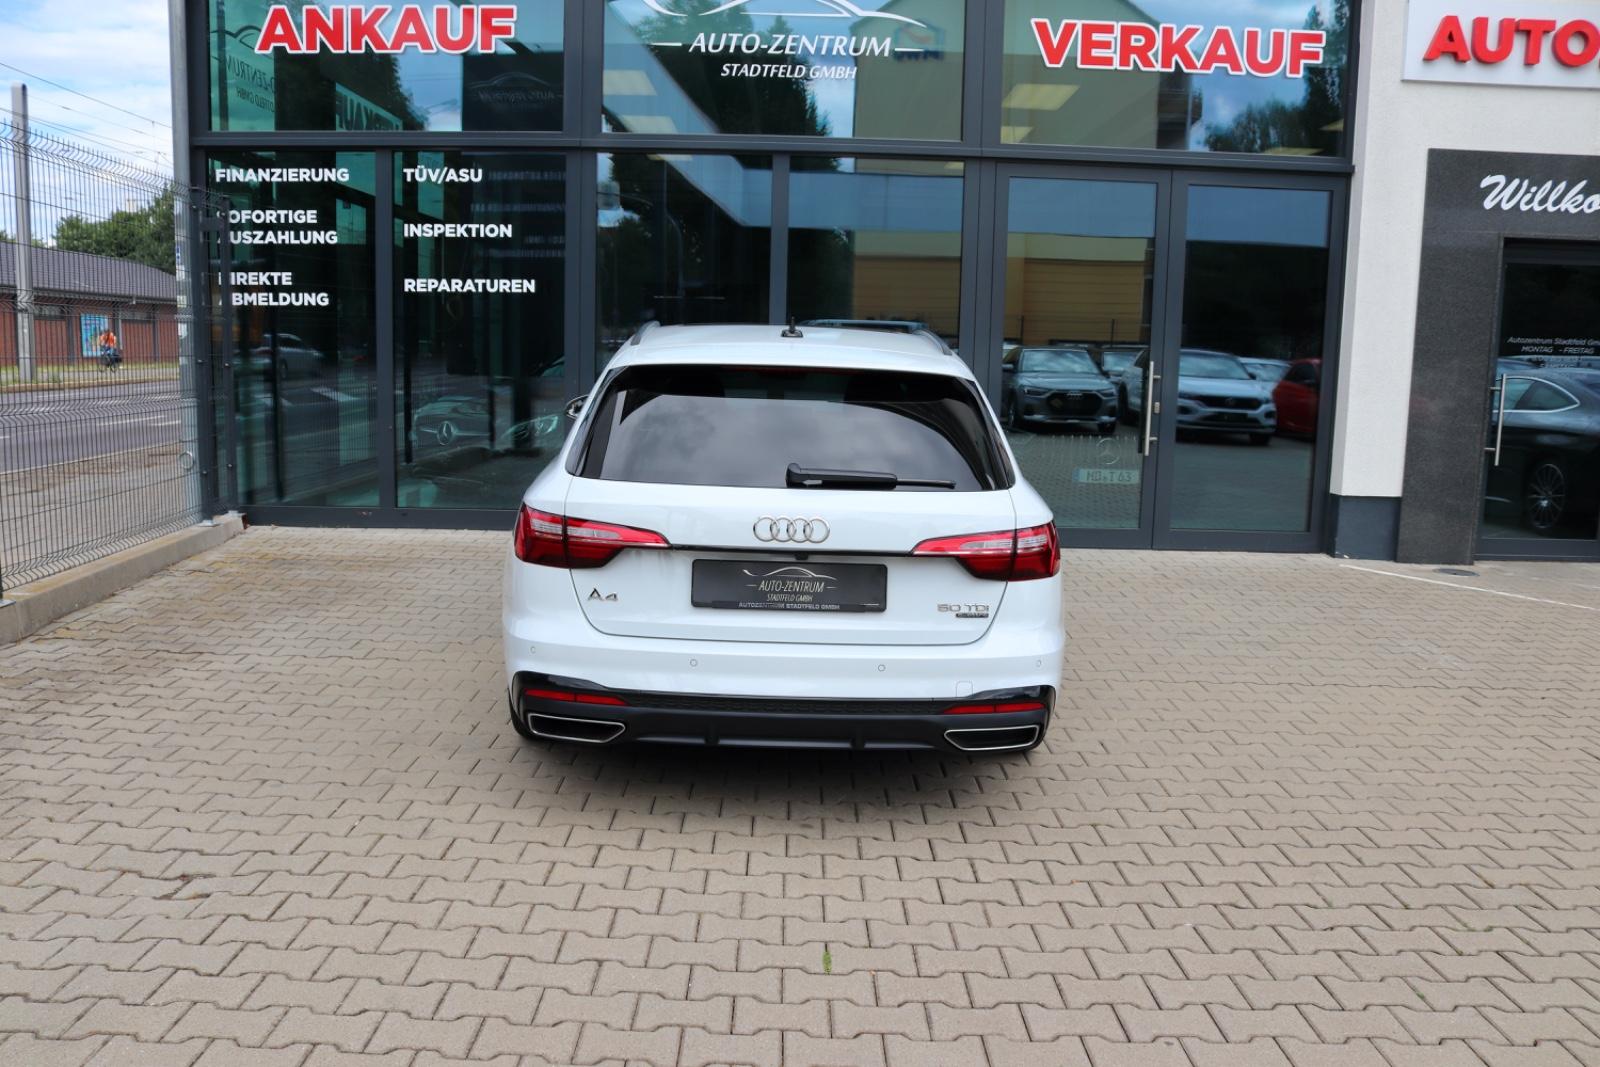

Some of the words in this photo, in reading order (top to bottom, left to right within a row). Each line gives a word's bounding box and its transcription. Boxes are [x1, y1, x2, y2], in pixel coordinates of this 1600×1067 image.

[254, 5, 517, 54] ANKAUF
[689, 33, 891, 57] AUTO-ZENTRUM
[1031, 17, 1326, 77] VERKAUF
[1423, 15, 1600, 68] AUTO
[721, 63, 806, 79] STADTFELD
[810, 65, 858, 80] GMBH
[215, 168, 350, 182] FINANZIERUNG
[403, 165, 483, 184] TÜV/ASU
[217, 230, 338, 245] USZAHLUNG
[404, 224, 513, 238] INSPEKTION
[219, 271, 293, 286] IREKTE
[404, 278, 536, 293] REPARATUREN
[219, 292, 330, 306] BMELDUNG
[1521, 345, 1553, 353] MONTAG
[1563, 346, 1595, 354] FREITAG
[758, 579, 825, 593] AUTO-ZENTRUM
[587, 588, 618, 601] A4
